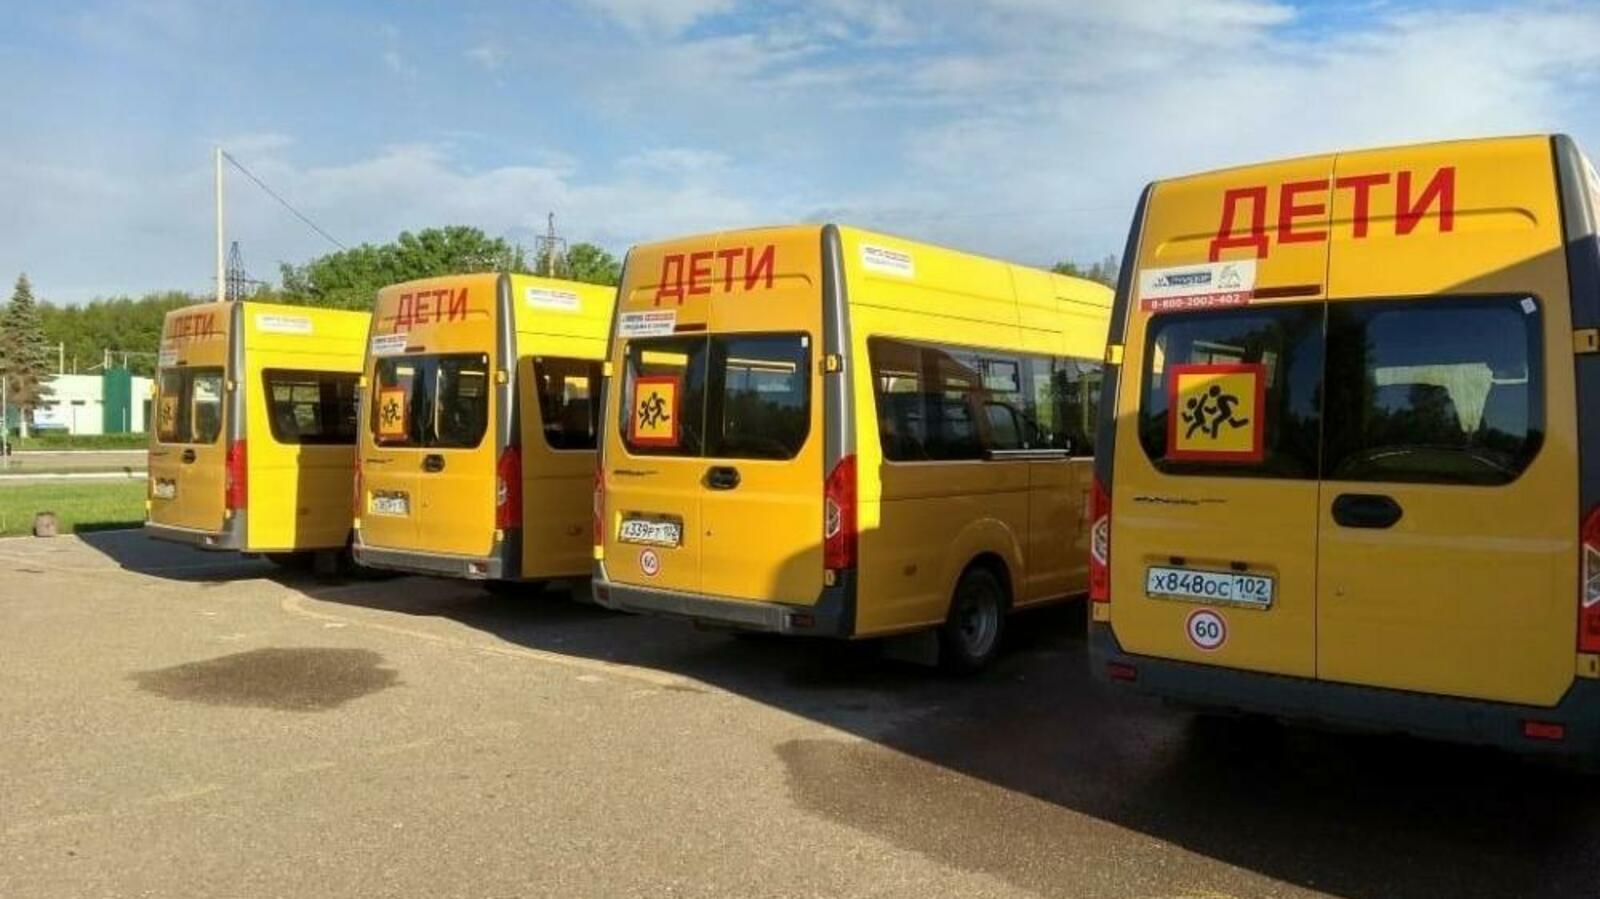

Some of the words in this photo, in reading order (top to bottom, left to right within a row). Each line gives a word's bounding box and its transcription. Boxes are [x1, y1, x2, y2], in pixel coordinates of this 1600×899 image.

[1208, 166, 1456, 262] ДЕТИ
[654, 244, 776, 307] ДЕТИ
[394, 287, 468, 332] ДЕТИ
[1153, 573, 1230, 597] Х848ОС
[1234, 577, 1268, 596] 102
[1194, 620, 1219, 639] 60
